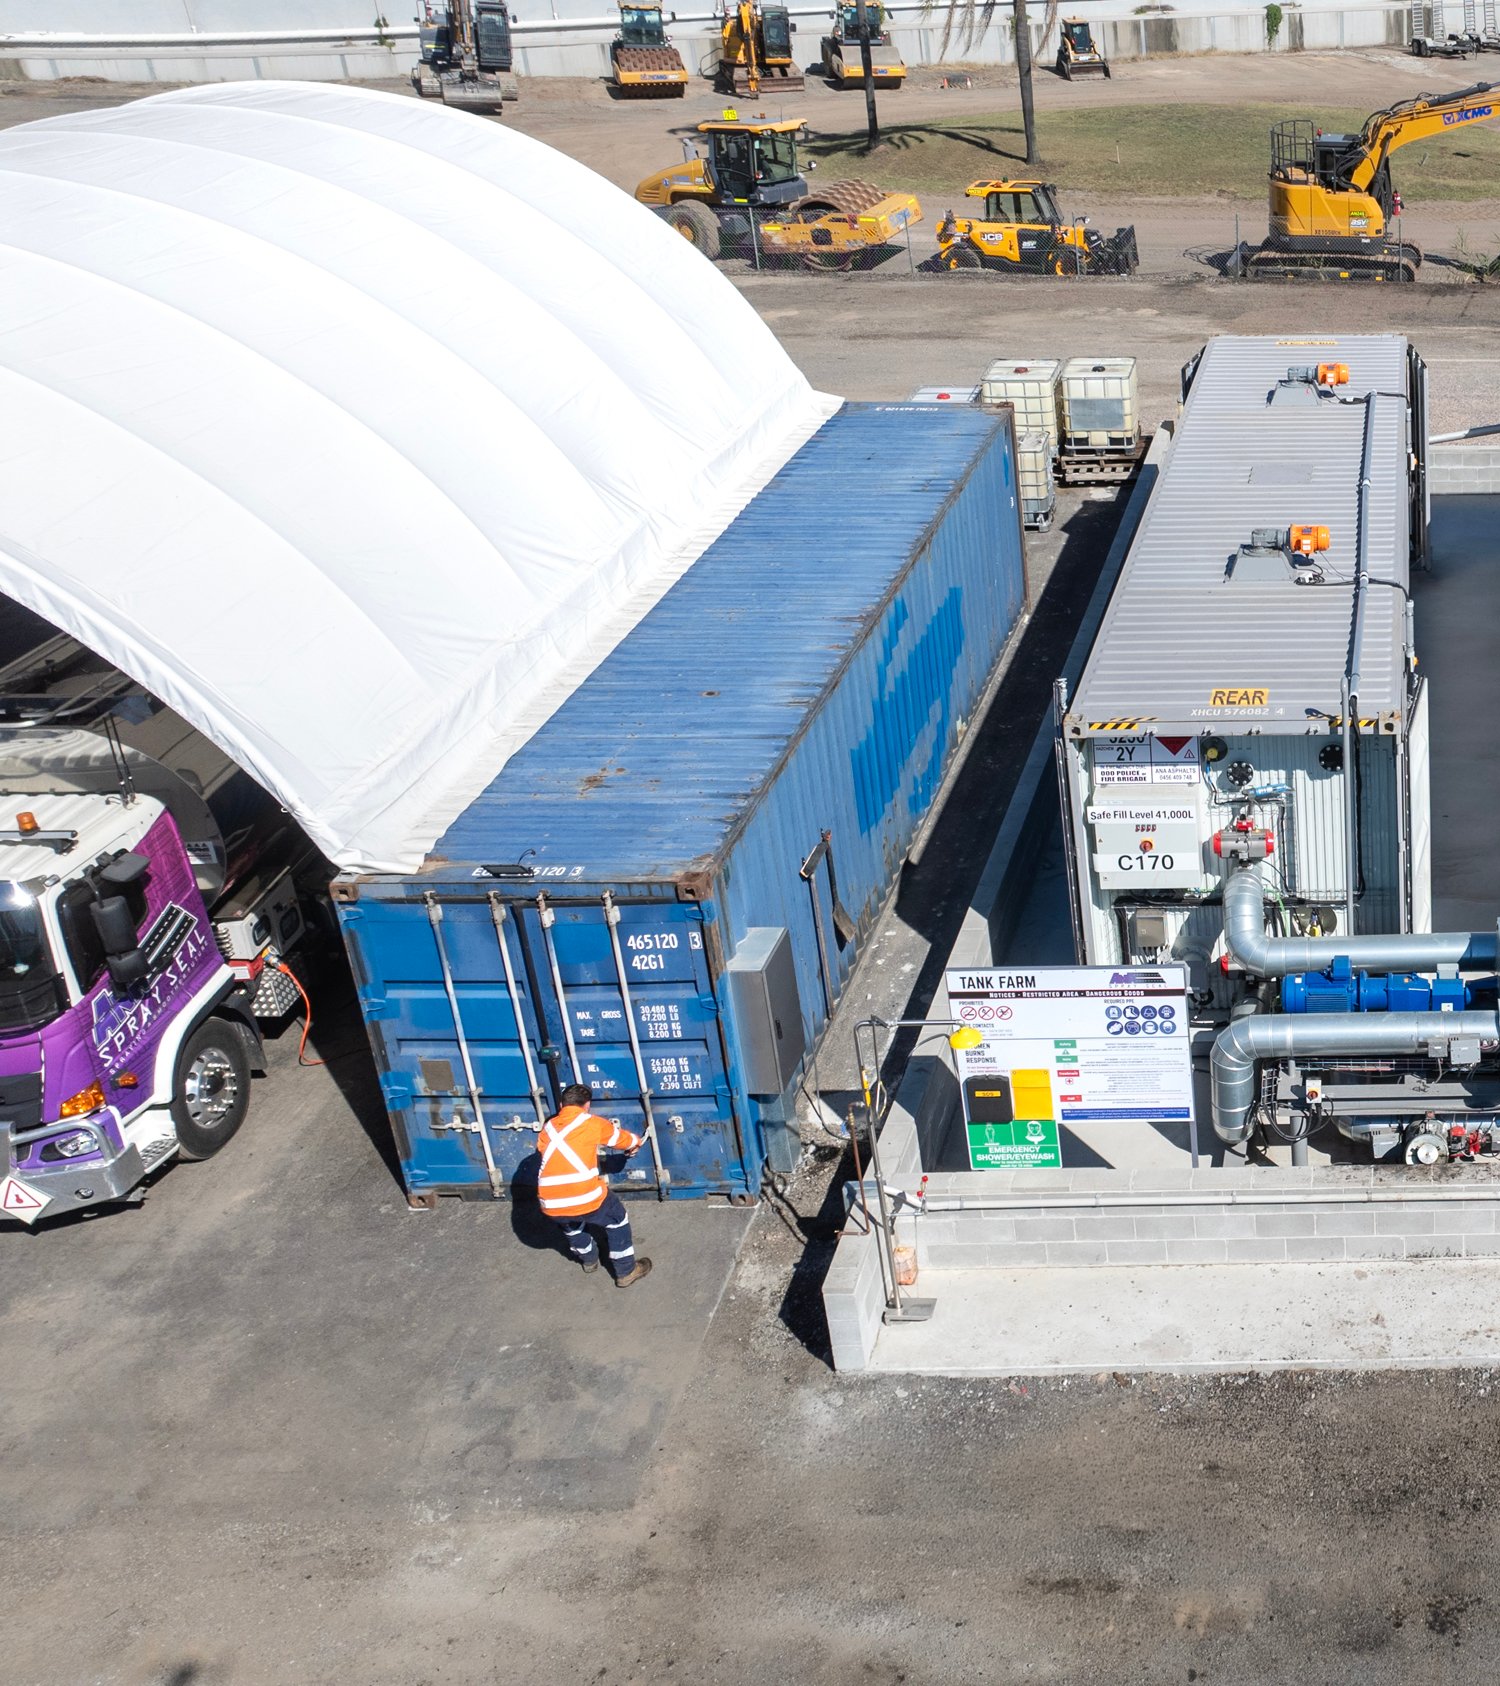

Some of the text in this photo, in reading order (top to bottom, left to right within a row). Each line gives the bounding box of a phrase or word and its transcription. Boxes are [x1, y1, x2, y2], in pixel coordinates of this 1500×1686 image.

[1455, 106, 1492, 122] XCMG
[981, 232, 1003, 241] JCB
[1212, 691, 1265, 705] REAR
[1190, 708, 1221, 716] XHCU
[1224, 708, 1270, 716] 576082
[1116, 746, 1136, 761] 2Y
[1090, 810, 1194, 820] Safe Fill Level 41,000L
[1118, 855, 1174, 871] C170
[627, 932, 702, 950] 465120 3
[632, 954, 664, 970] 42G1
[960, 975, 1036, 989] TANK FARM
[99, 929, 205, 1067] SPRAY SEAL
[576, 1011, 592, 1019] MAX.
[641, 1006, 665, 1014] 30.480
[669, 1005, 678, 1013] KG
[641, 1013, 666, 1021] 67.200
[672, 1022, 681, 1030] KG
[651, 1058, 675, 1066] 26.760
[976, 1153, 1055, 1161] SHOWER/EYEWASH
